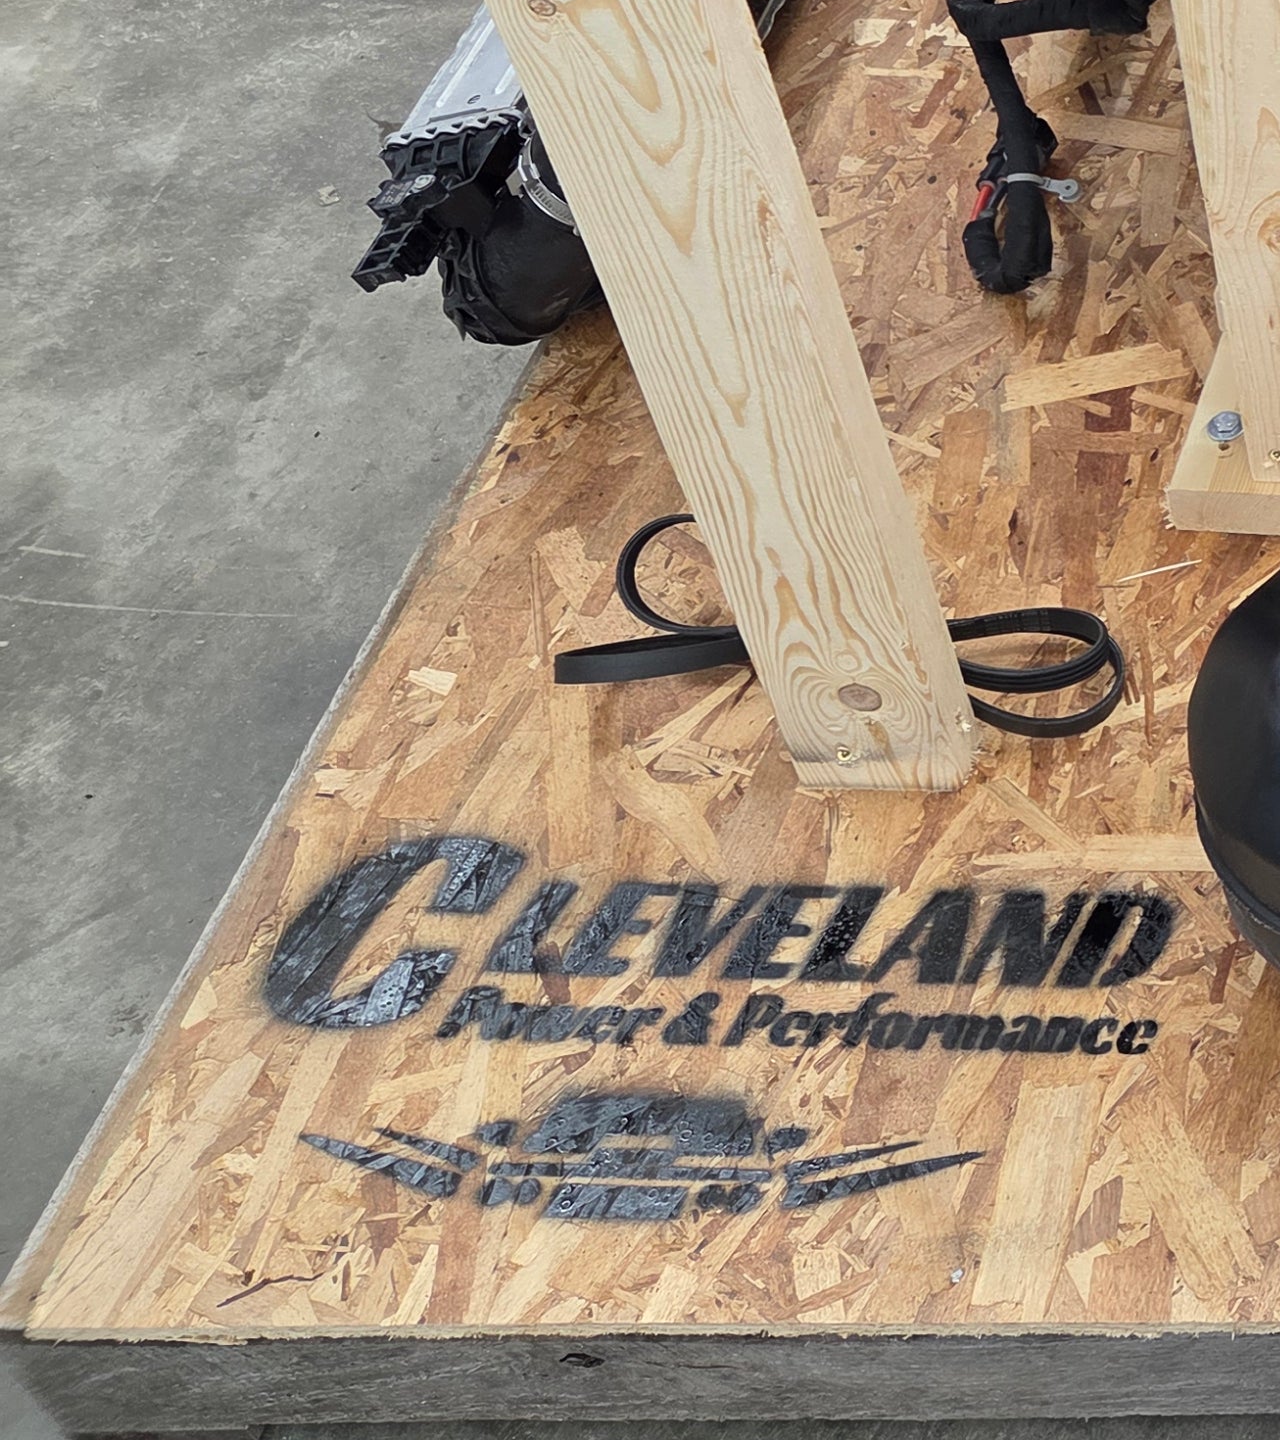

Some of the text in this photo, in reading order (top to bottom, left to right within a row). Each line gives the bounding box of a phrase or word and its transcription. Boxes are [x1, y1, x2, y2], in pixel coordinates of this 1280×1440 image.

[263, 835, 1174, 1029] CLEVELAND
[436, 984, 1159, 1056] Power & Performance
